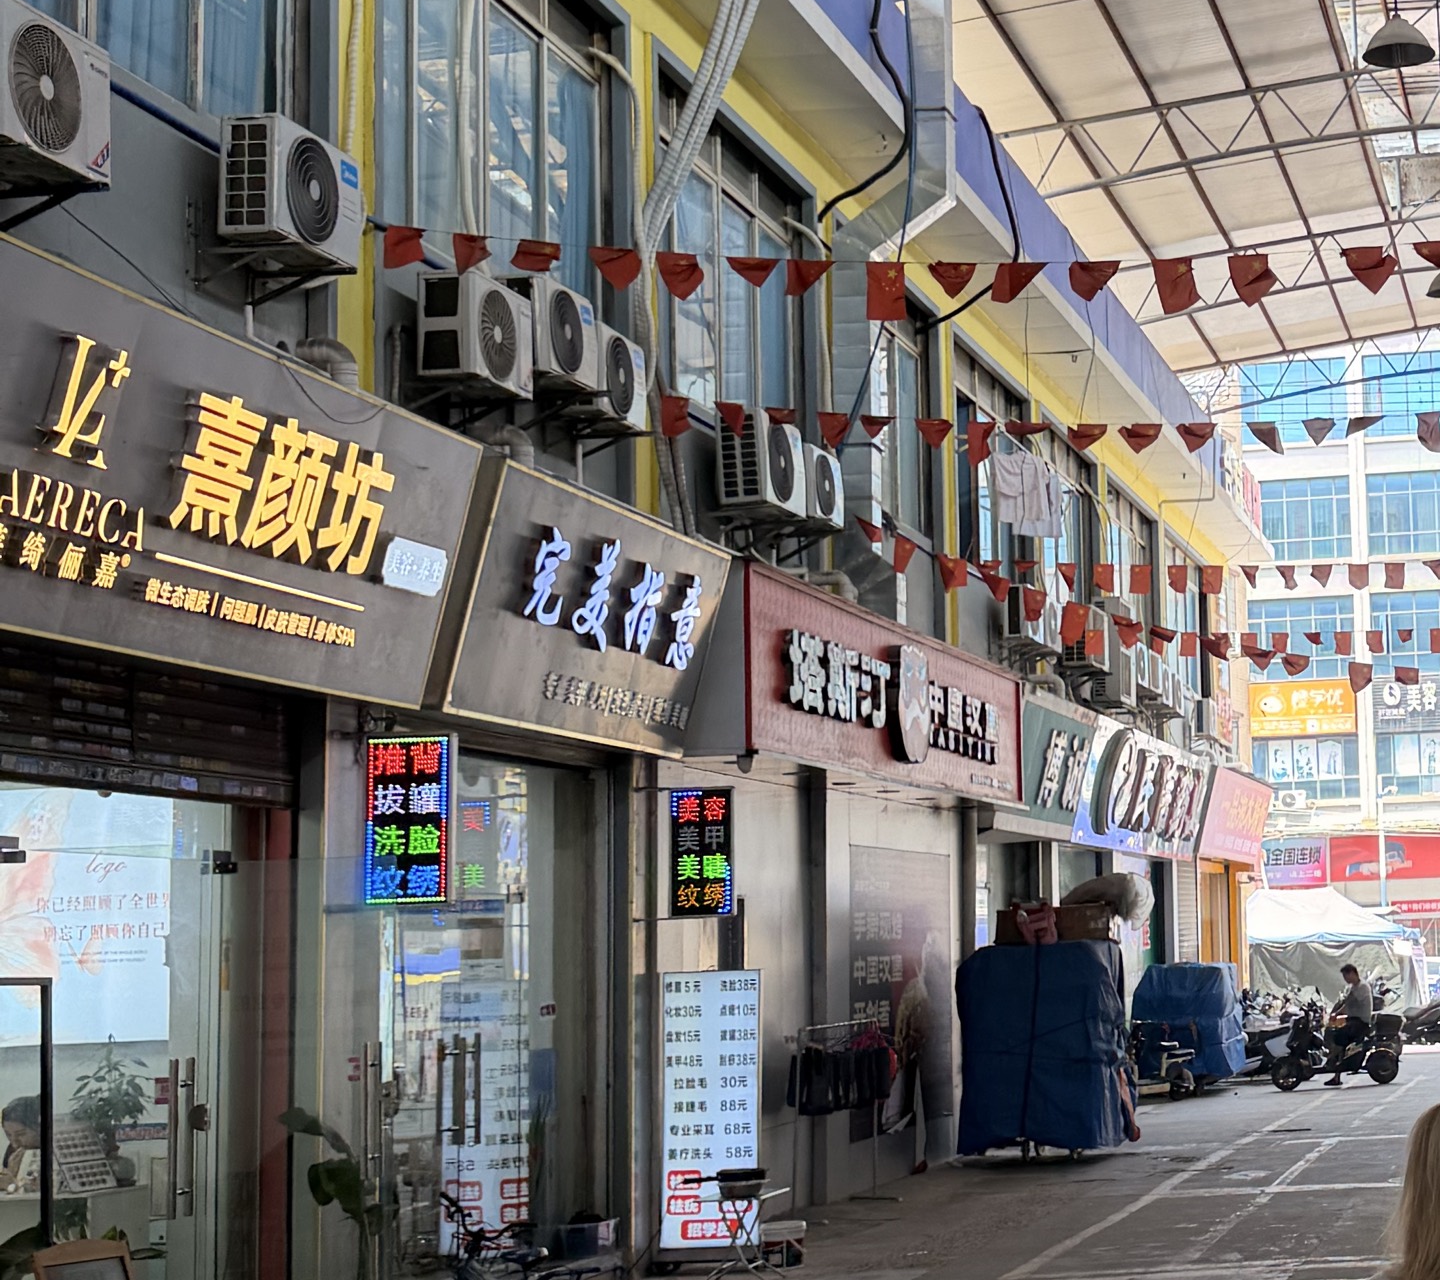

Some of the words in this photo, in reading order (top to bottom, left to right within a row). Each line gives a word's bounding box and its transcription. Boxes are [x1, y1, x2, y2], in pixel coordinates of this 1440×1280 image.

[789, 628, 892, 729] 塔斯汀
[1406, 681, 1437, 712] 美容
[373, 742, 441, 776] 推背
[373, 782, 442, 815] 拔罐
[678, 796, 726, 823] 美容
[373, 823, 441, 856] 洗脸
[677, 825, 725, 852] 美甲
[86, 850, 128, 883] logo
[372, 864, 441, 897] 纹绣
[677, 882, 726, 908] 纹绣
[43, 922, 166, 942] 别忘了照顾你自己
[853, 955, 903, 986] 中国汉堡
[720, 1075, 748, 1088] 30元
[720, 1099, 748, 1112] 88元
[669, 1124, 715, 1136] 专业采耳
[724, 1122, 752, 1135] 68元
[725, 1146, 753, 1159] 58元
